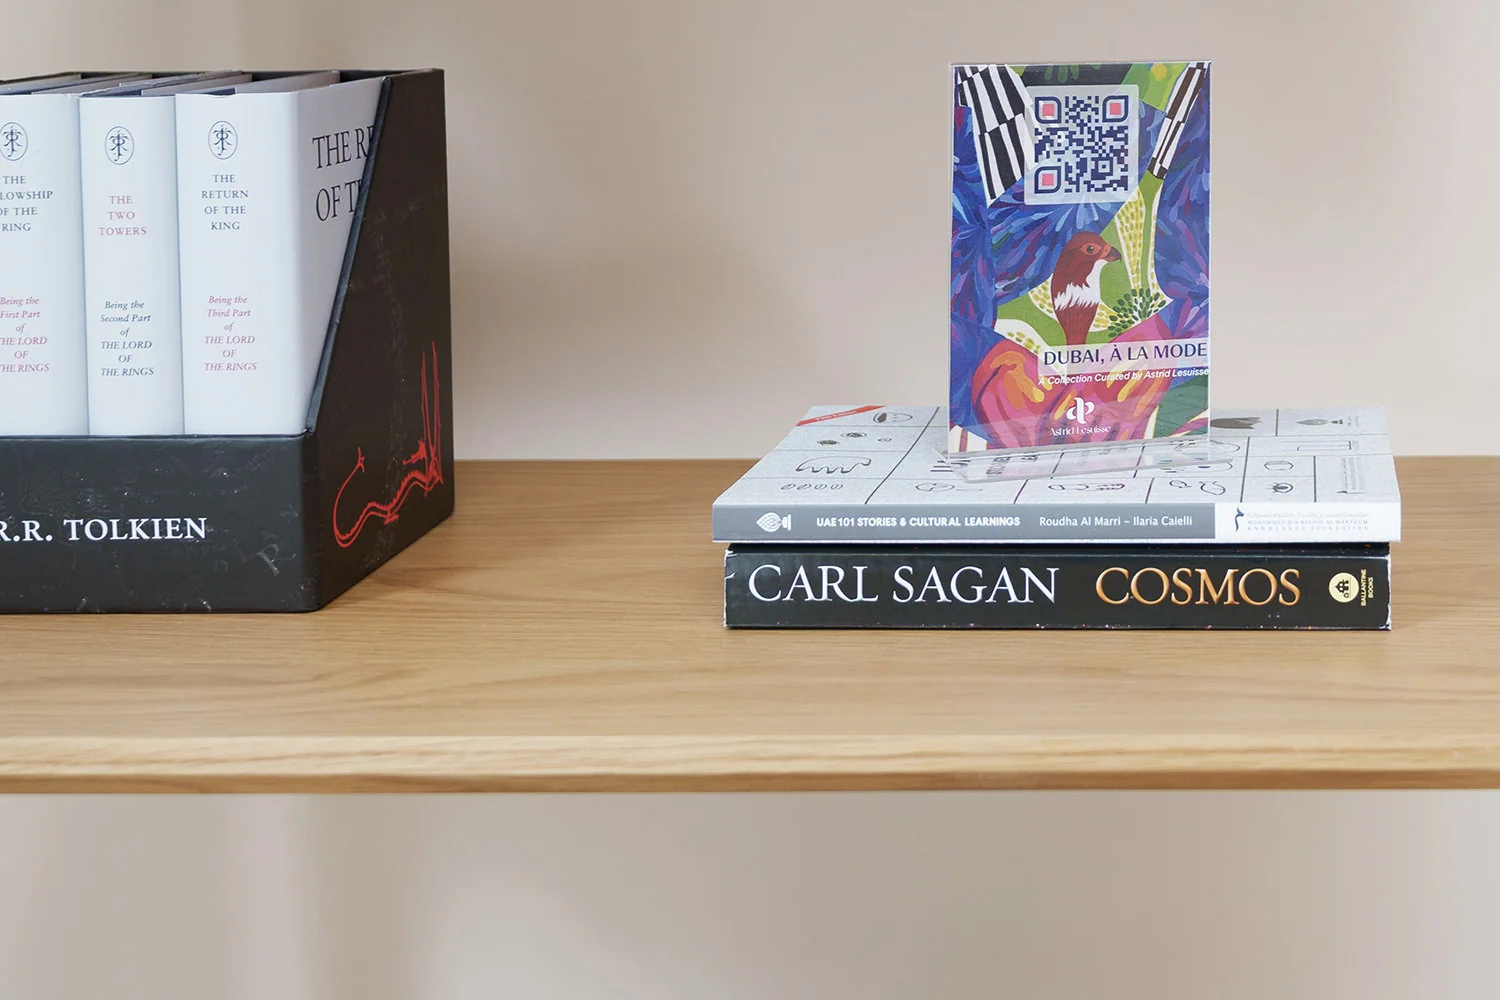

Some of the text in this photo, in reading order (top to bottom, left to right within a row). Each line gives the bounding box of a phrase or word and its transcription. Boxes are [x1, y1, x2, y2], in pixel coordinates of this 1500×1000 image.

[312, 130, 352, 169] THE
[3, 176, 27, 184] THE
[212, 174, 236, 183] THE
[201, 190, 249, 199] RETURN
[109, 195, 133, 204] THE
[316, 179, 362, 221] OF T
[12, 207, 38, 215] THE
[204, 205, 247, 215] OF THE
[107, 211, 136, 220] TWO
[2, 223, 31, 232] RING
[211, 221, 240, 230] KING
[98, 226, 147, 236] TOWERS
[0, 296, 39, 307] Being the
[209, 295, 248, 306] Being the
[104, 300, 145, 311] Being the
[207, 309, 251, 317] Third Part
[100, 314, 151, 322] Second Part
[15, 323, 26, 334] of
[224, 322, 234, 332] of
[120, 327, 131, 338] of
[17, 336, 48, 345] LORD
[101, 340, 152, 349] THE LORD
[205, 336, 255, 344] THE LORD
[14, 351, 29, 359] OF
[222, 349, 237, 357] OF
[1044, 343, 1207, 365] DUBAI, À LA MODE
[118, 354, 133, 363] OF
[0, 363, 50, 372] HE RINGS
[205, 362, 257, 371] THE RINGS
[101, 367, 154, 376] THE RINGS
[1047, 373, 1093, 385] Collection
[1097, 372, 1130, 382] Curated
[1132, 371, 1142, 381] by
[1144, 370, 1171, 379] Astrid
[1172, 367, 1209, 377] Lesuisse
[816, 517, 1021, 527] UAE 101 STORIES & CULTURAL LEARNINGS
[1039, 516, 1078, 526] Roudha
[1081, 516, 1091, 526] Al
[1095, 516, 1121, 526] Marri
[1133, 516, 1158, 526] Ilaria
[1161, 516, 1193, 526] Caielli
[64, 517, 207, 541] TOLKIEN
[749, 564, 1301, 606] CARL SAGAN COSMOS
